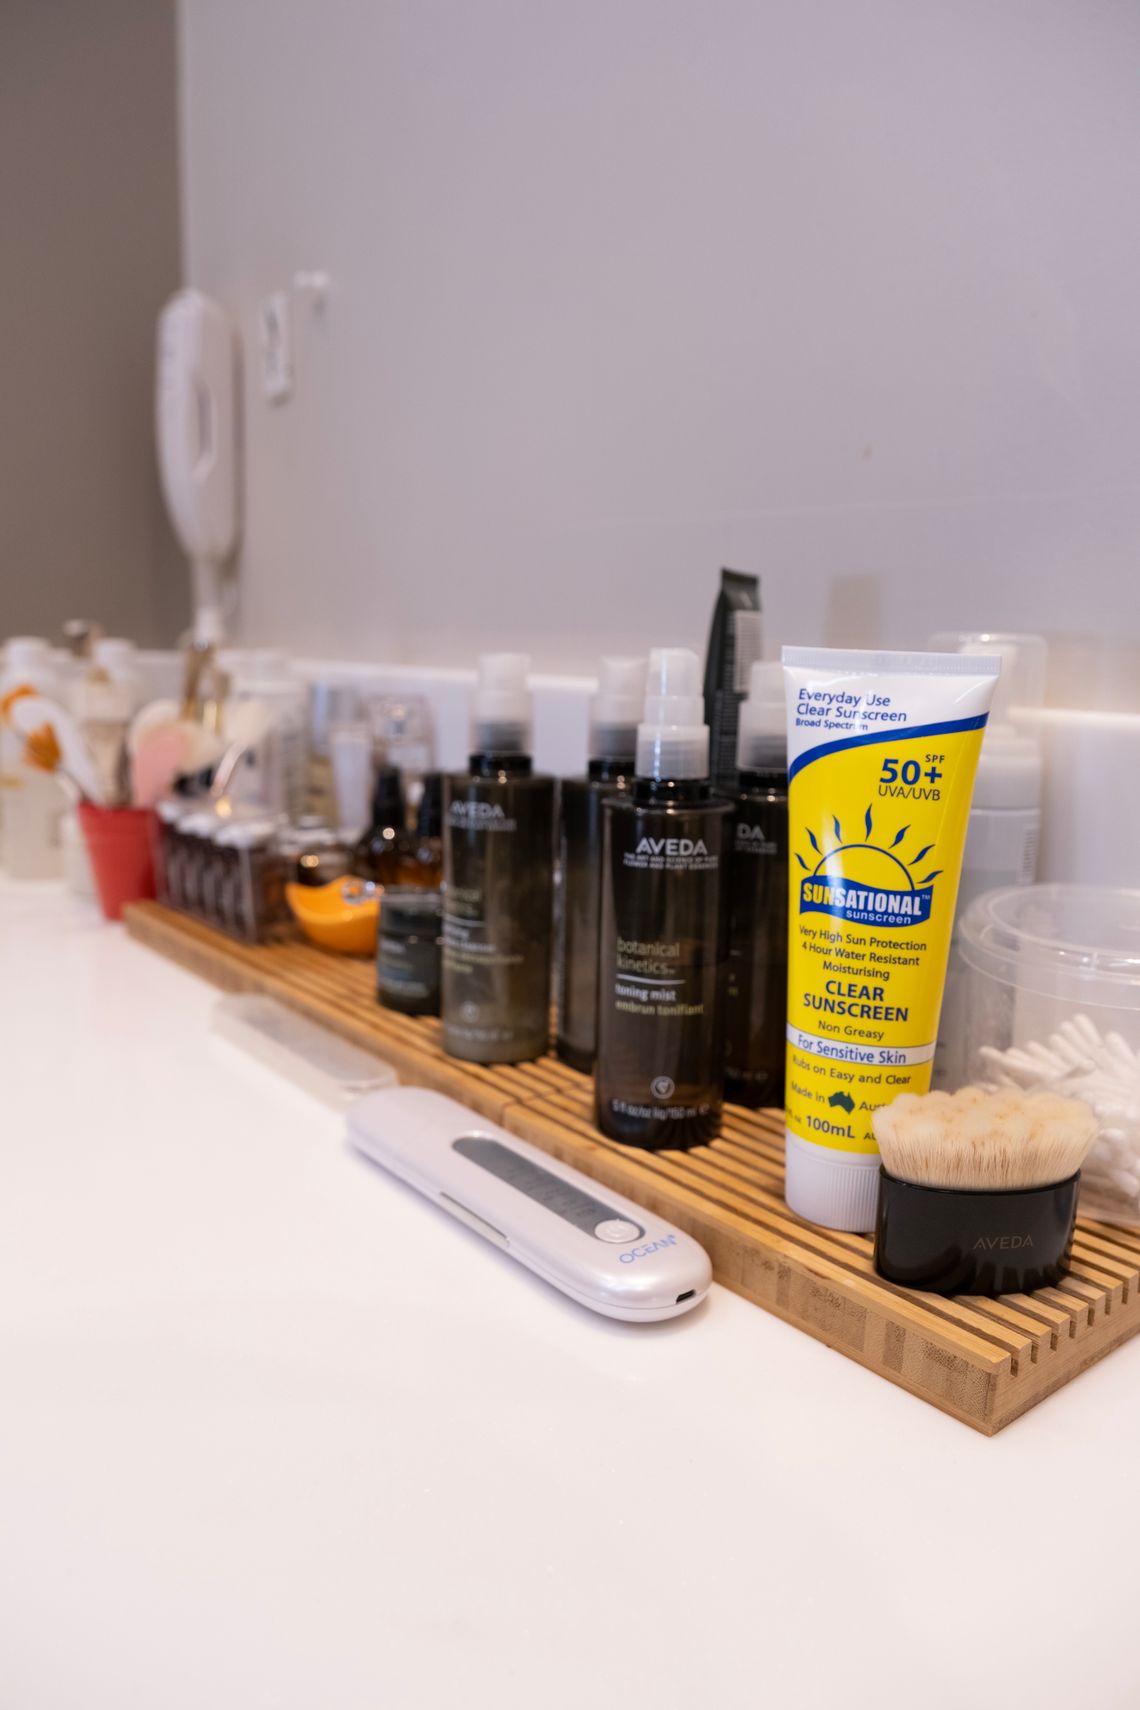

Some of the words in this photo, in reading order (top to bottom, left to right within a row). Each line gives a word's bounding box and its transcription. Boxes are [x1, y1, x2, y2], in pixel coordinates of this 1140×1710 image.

[798, 688, 861, 707] Everyday
[866, 693, 891, 707] Use
[796, 703, 831, 718] Clear
[836, 706, 907, 722] Sunscreen
[795, 718, 821, 728] Broad
[823, 719, 868, 731] Spectrm
[925, 754, 945, 764] SPF
[879, 758, 942, 785] 50+
[878, 785, 941, 801] UVA/UVB
[636, 837, 708, 856] AVEDA
[803, 882, 922, 916] SUNSATIONAL
[846, 909, 911, 924] sunscreen
[617, 936, 680, 957] botanical
[799, 925, 817, 940] Very
[819, 930, 843, 944] High
[846, 933, 866, 946] Sun
[869, 937, 927, 951] Protection
[802, 941, 808, 950] 4
[809, 943, 832, 955] Hour
[834, 947, 866, 961] Water
[869, 952, 920, 967] Resistant
[822, 960, 890, 981] Moisturising
[615, 983, 649, 1002] toning
[651, 988, 676, 1002] mist
[825, 980, 884, 1001] CLEAR
[803, 993, 909, 1022] SUNSCREEN
[818, 1020, 840, 1034] Non
[844, 1026, 884, 1041] Greasy
[798, 1034, 813, 1050] For
[817, 1040, 874, 1063] Sensitive
[879, 1050, 906, 1064] Skin
[813, 1065, 826, 1076] on
[830, 1068, 855, 1083] Easy
[858, 1074, 881, 1085] and
[885, 1074, 911, 1085] Clear
[791, 1081, 813, 1099] Made
[815, 1091, 825, 1103] in
[806, 1115, 856, 1139] 100mL
[618, 1236, 674, 1264] OCEAN
[973, 1235, 1034, 1250] AVEDA
